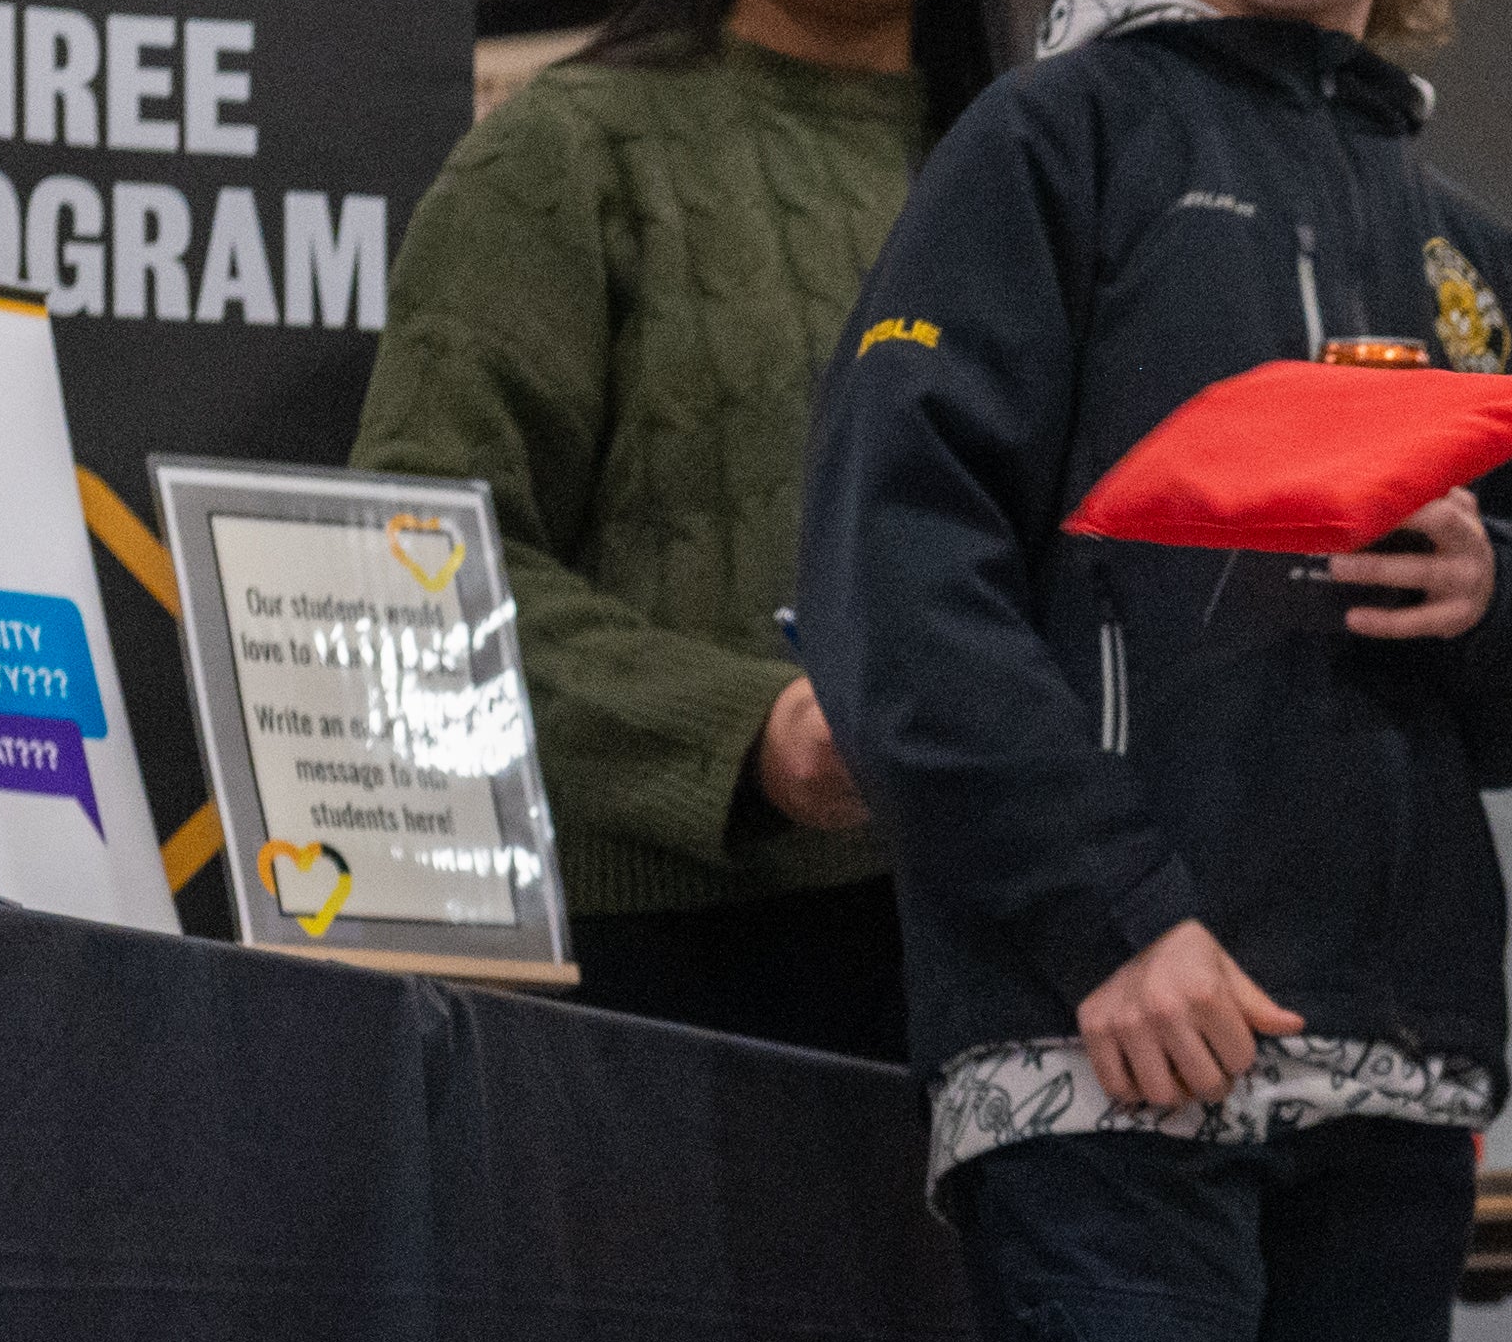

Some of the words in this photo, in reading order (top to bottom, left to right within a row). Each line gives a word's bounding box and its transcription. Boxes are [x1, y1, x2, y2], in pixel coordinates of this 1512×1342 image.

[245, 586, 283, 617] Our
[291, 592, 380, 625] students
[241, 631, 284, 665] love
[291, 638, 312, 666] to
[253, 705, 313, 738] Write
[295, 758, 385, 792] message
[390, 758, 412, 789] to
[310, 801, 400, 833] students
